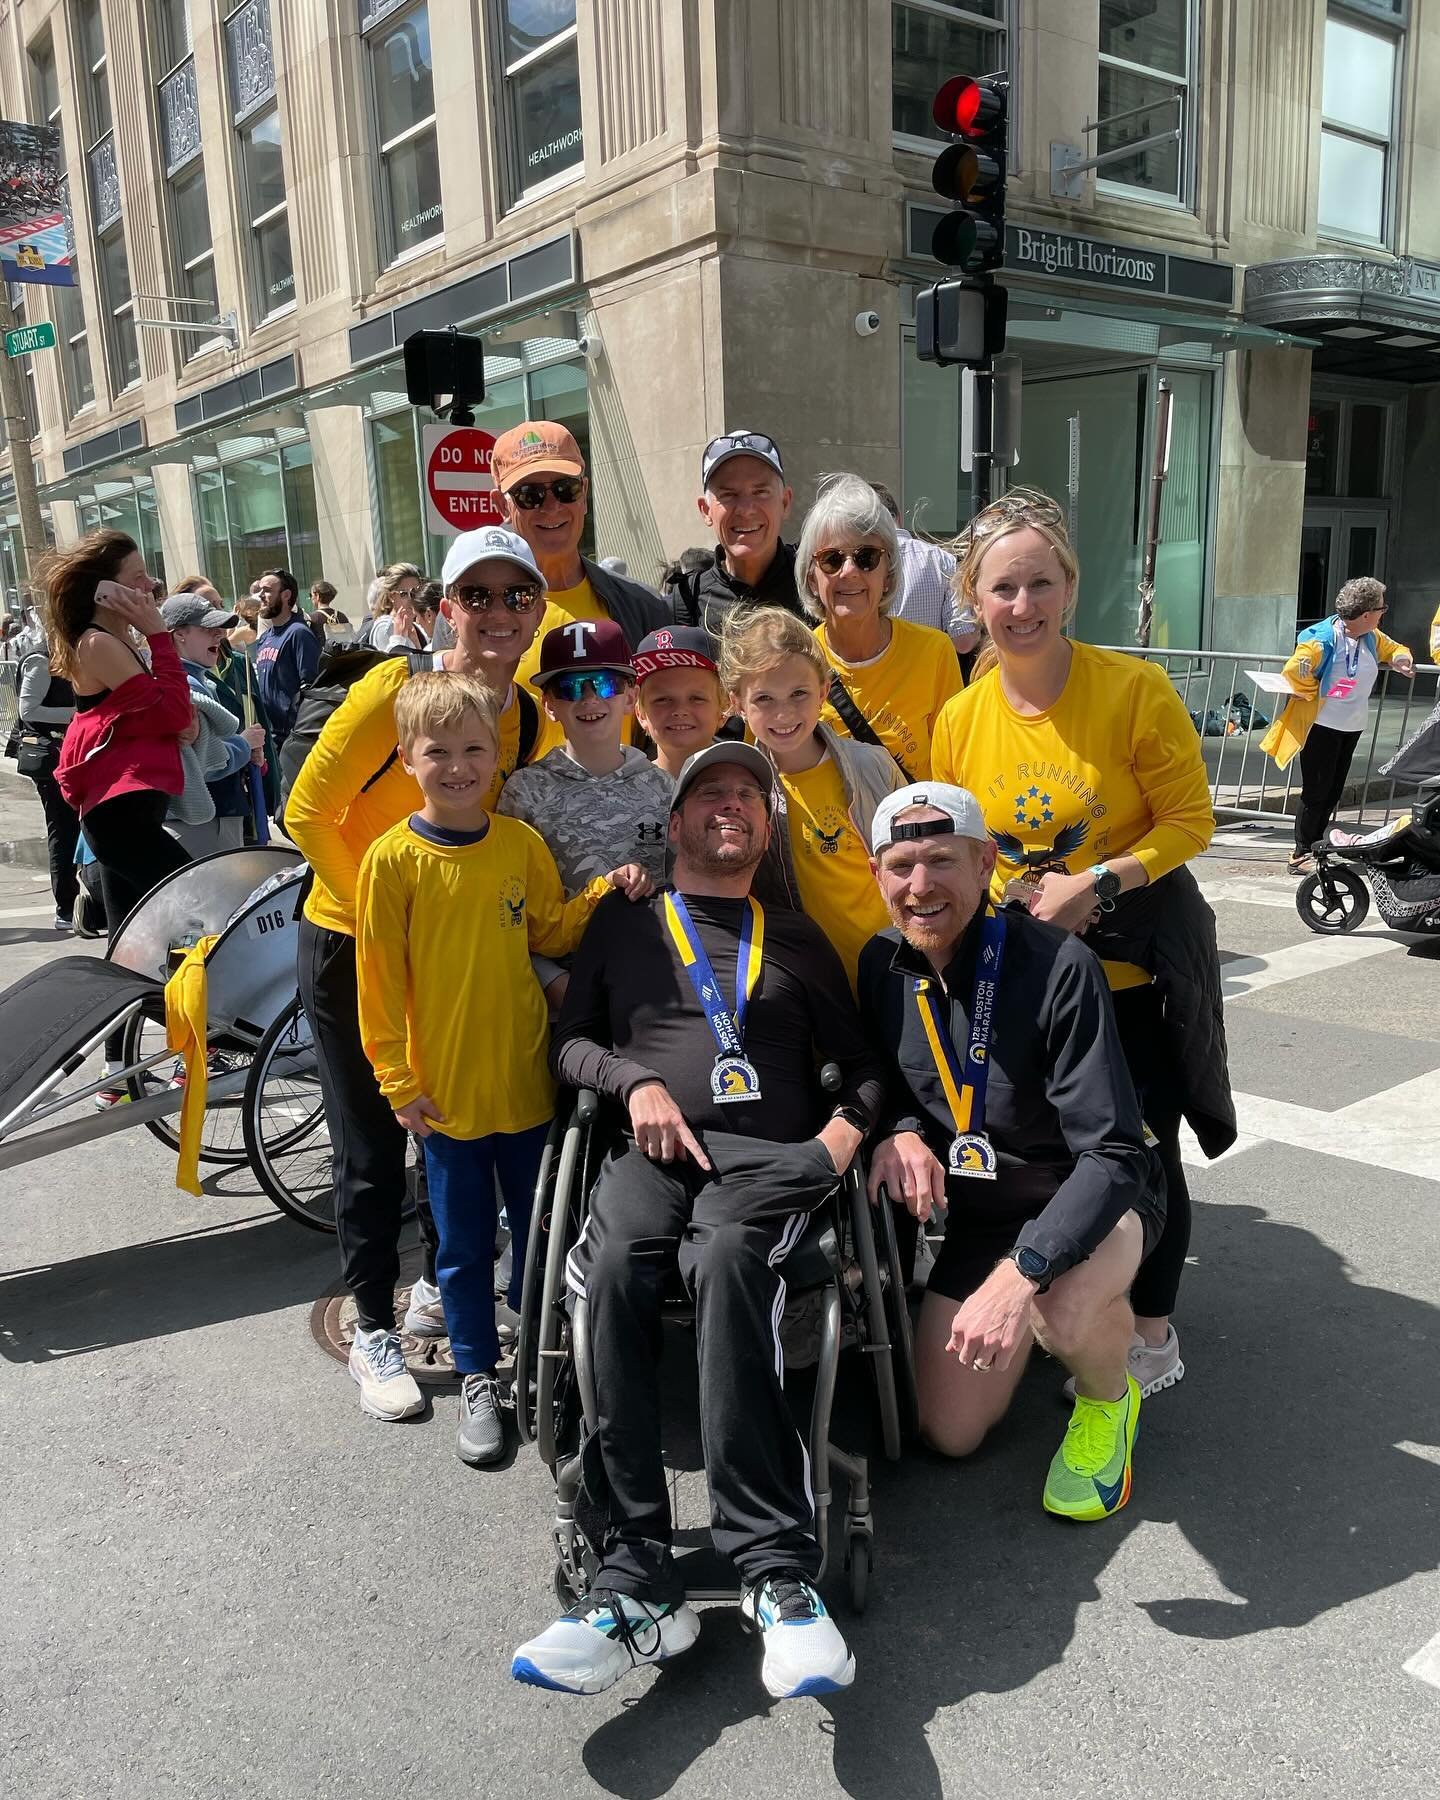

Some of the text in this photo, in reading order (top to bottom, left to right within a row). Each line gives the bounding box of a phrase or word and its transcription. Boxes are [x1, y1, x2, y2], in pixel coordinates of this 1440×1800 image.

[528, 127, 584, 167] HEALTHWORK
[401, 203, 443, 233] HEALTHWORK
[1017, 229, 1073, 273] Bright
[12, 328, 38, 352] STUART
[440, 447, 494, 465] DO NO
[563, 622, 596, 658] T
[630, 652, 706, 677] ED SOX
[988, 774, 1005, 798] IT
[1017, 761, 1106, 818] RUNNING
[256, 910, 285, 934] D16
[974, 980, 987, 1020] BOSTON
[980, 982, 995, 1042] MARATHON
[712, 1014, 732, 1050] BOSTON
[719, 1011, 742, 1054] RATHON
